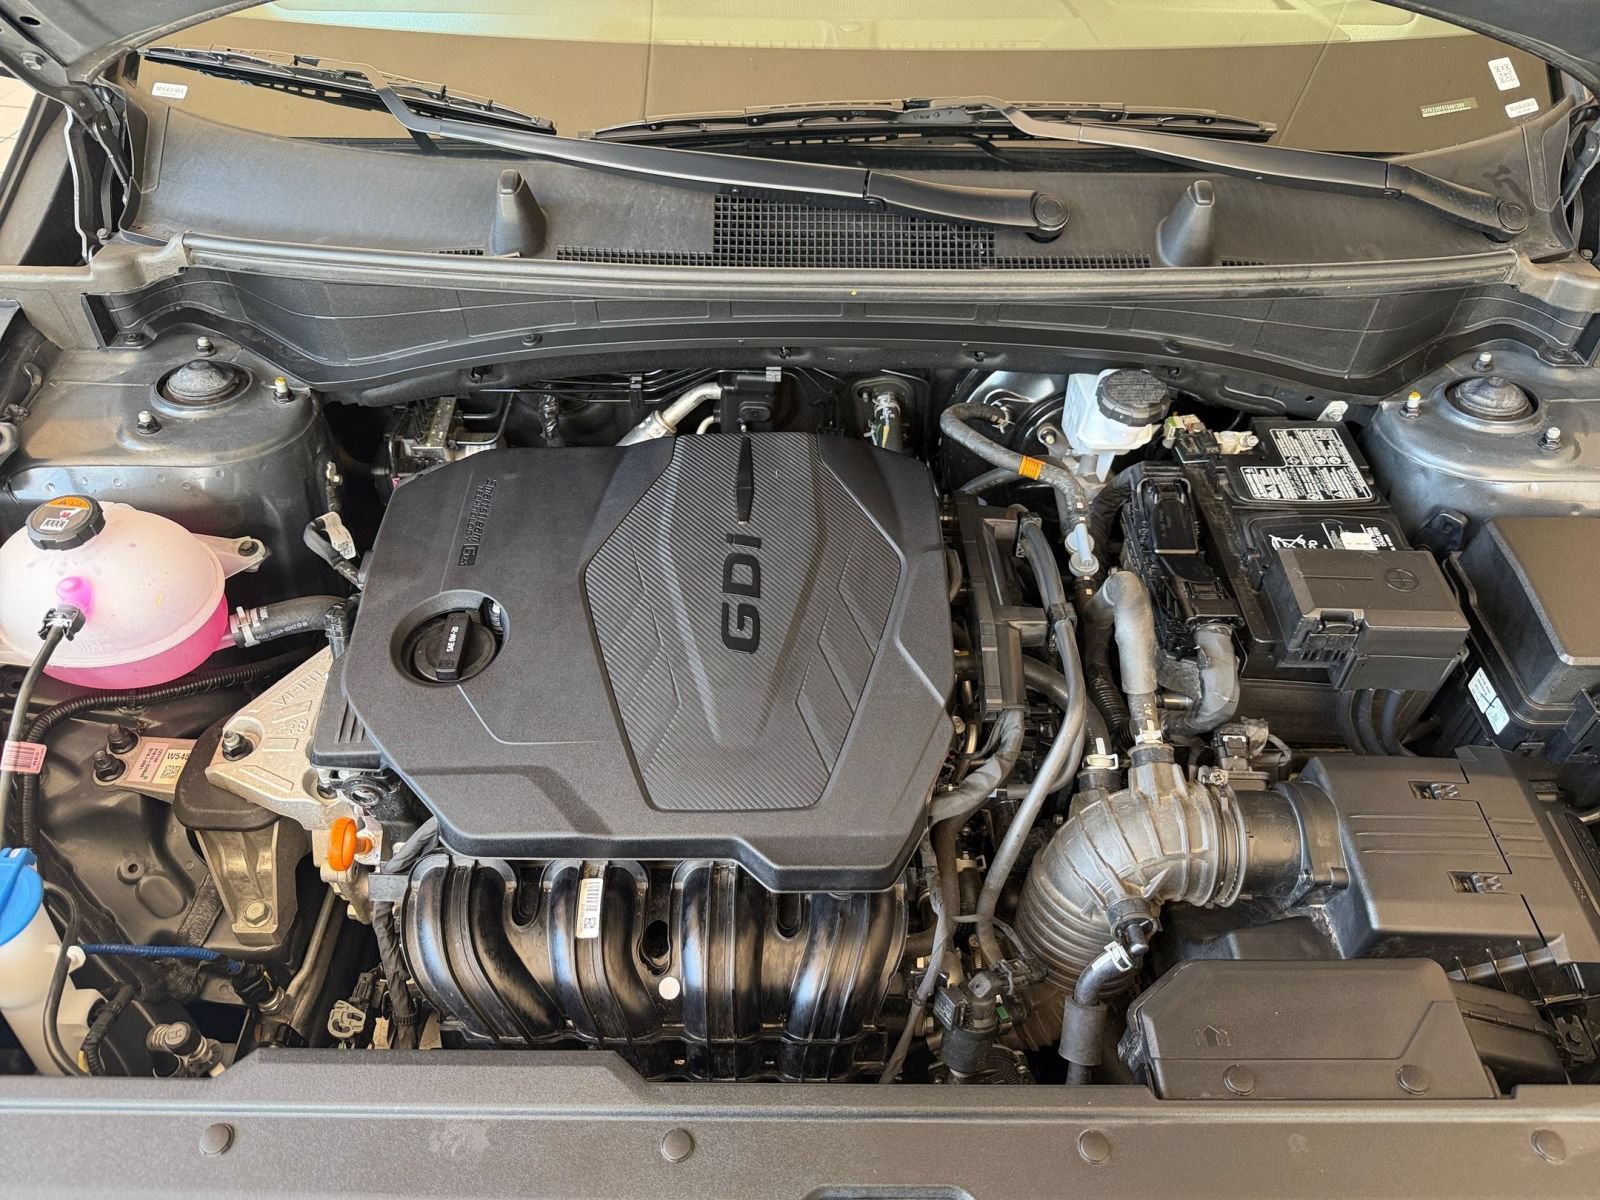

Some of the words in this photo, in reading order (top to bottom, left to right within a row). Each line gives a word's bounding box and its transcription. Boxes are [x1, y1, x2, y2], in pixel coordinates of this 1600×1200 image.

[464, 484, 484, 545] TECHNOLOGY
[472, 478, 497, 543] Smartstream
[721, 533, 762, 654] GDi
